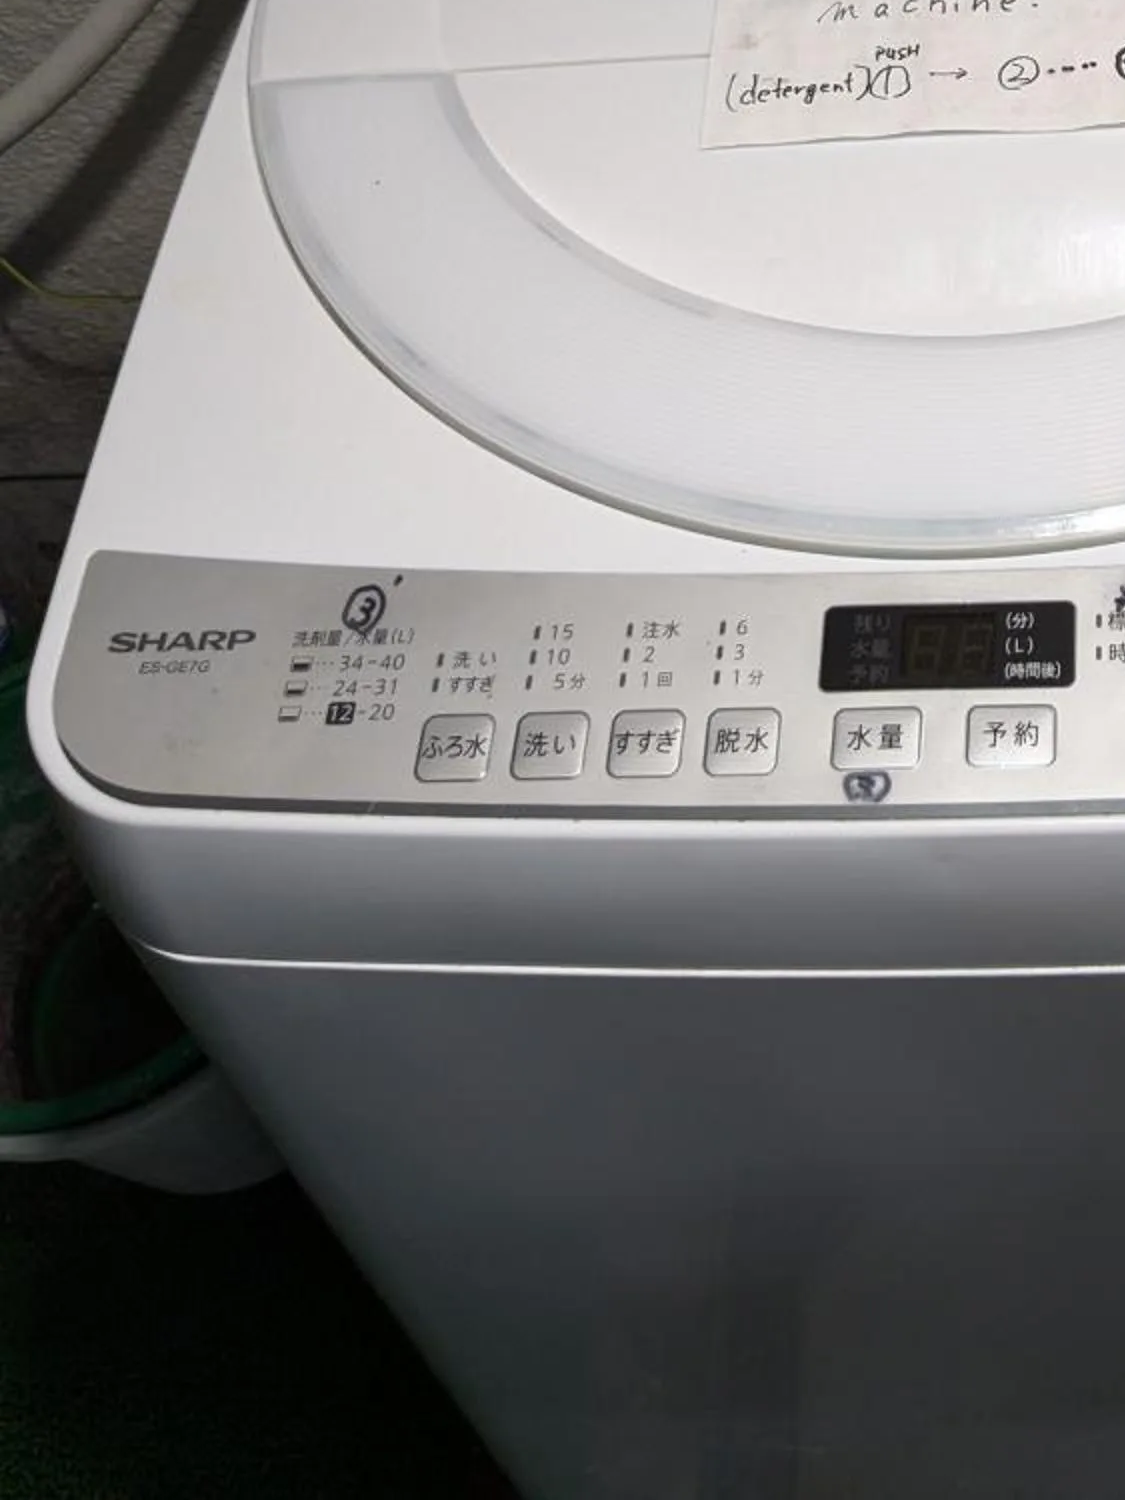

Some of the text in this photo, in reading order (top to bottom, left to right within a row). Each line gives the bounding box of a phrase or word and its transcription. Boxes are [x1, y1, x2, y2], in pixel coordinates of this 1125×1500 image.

[550, 623, 574, 640] 15
[642, 620, 682, 639] 注水
[736, 619, 748, 635] 6
[108, 630, 256, 653] SHARP
[339, 653, 405, 670] 34-40
[452, 651, 497, 669] 洗い
[548, 649, 571, 665] 10
[643, 647, 656, 663] 2
[734, 644, 745, 661] 3
[332, 679, 398, 697] 24-31
[450, 676, 494, 693] すすぎ
[614, 728, 679, 755] すすぎ
[715, 727, 770, 754] 脱水
[847, 723, 904, 750] 水量
[983, 721, 1040, 748] 予約
[422, 736, 487, 759] ふろ水
[524, 731, 578, 757] 洗い
